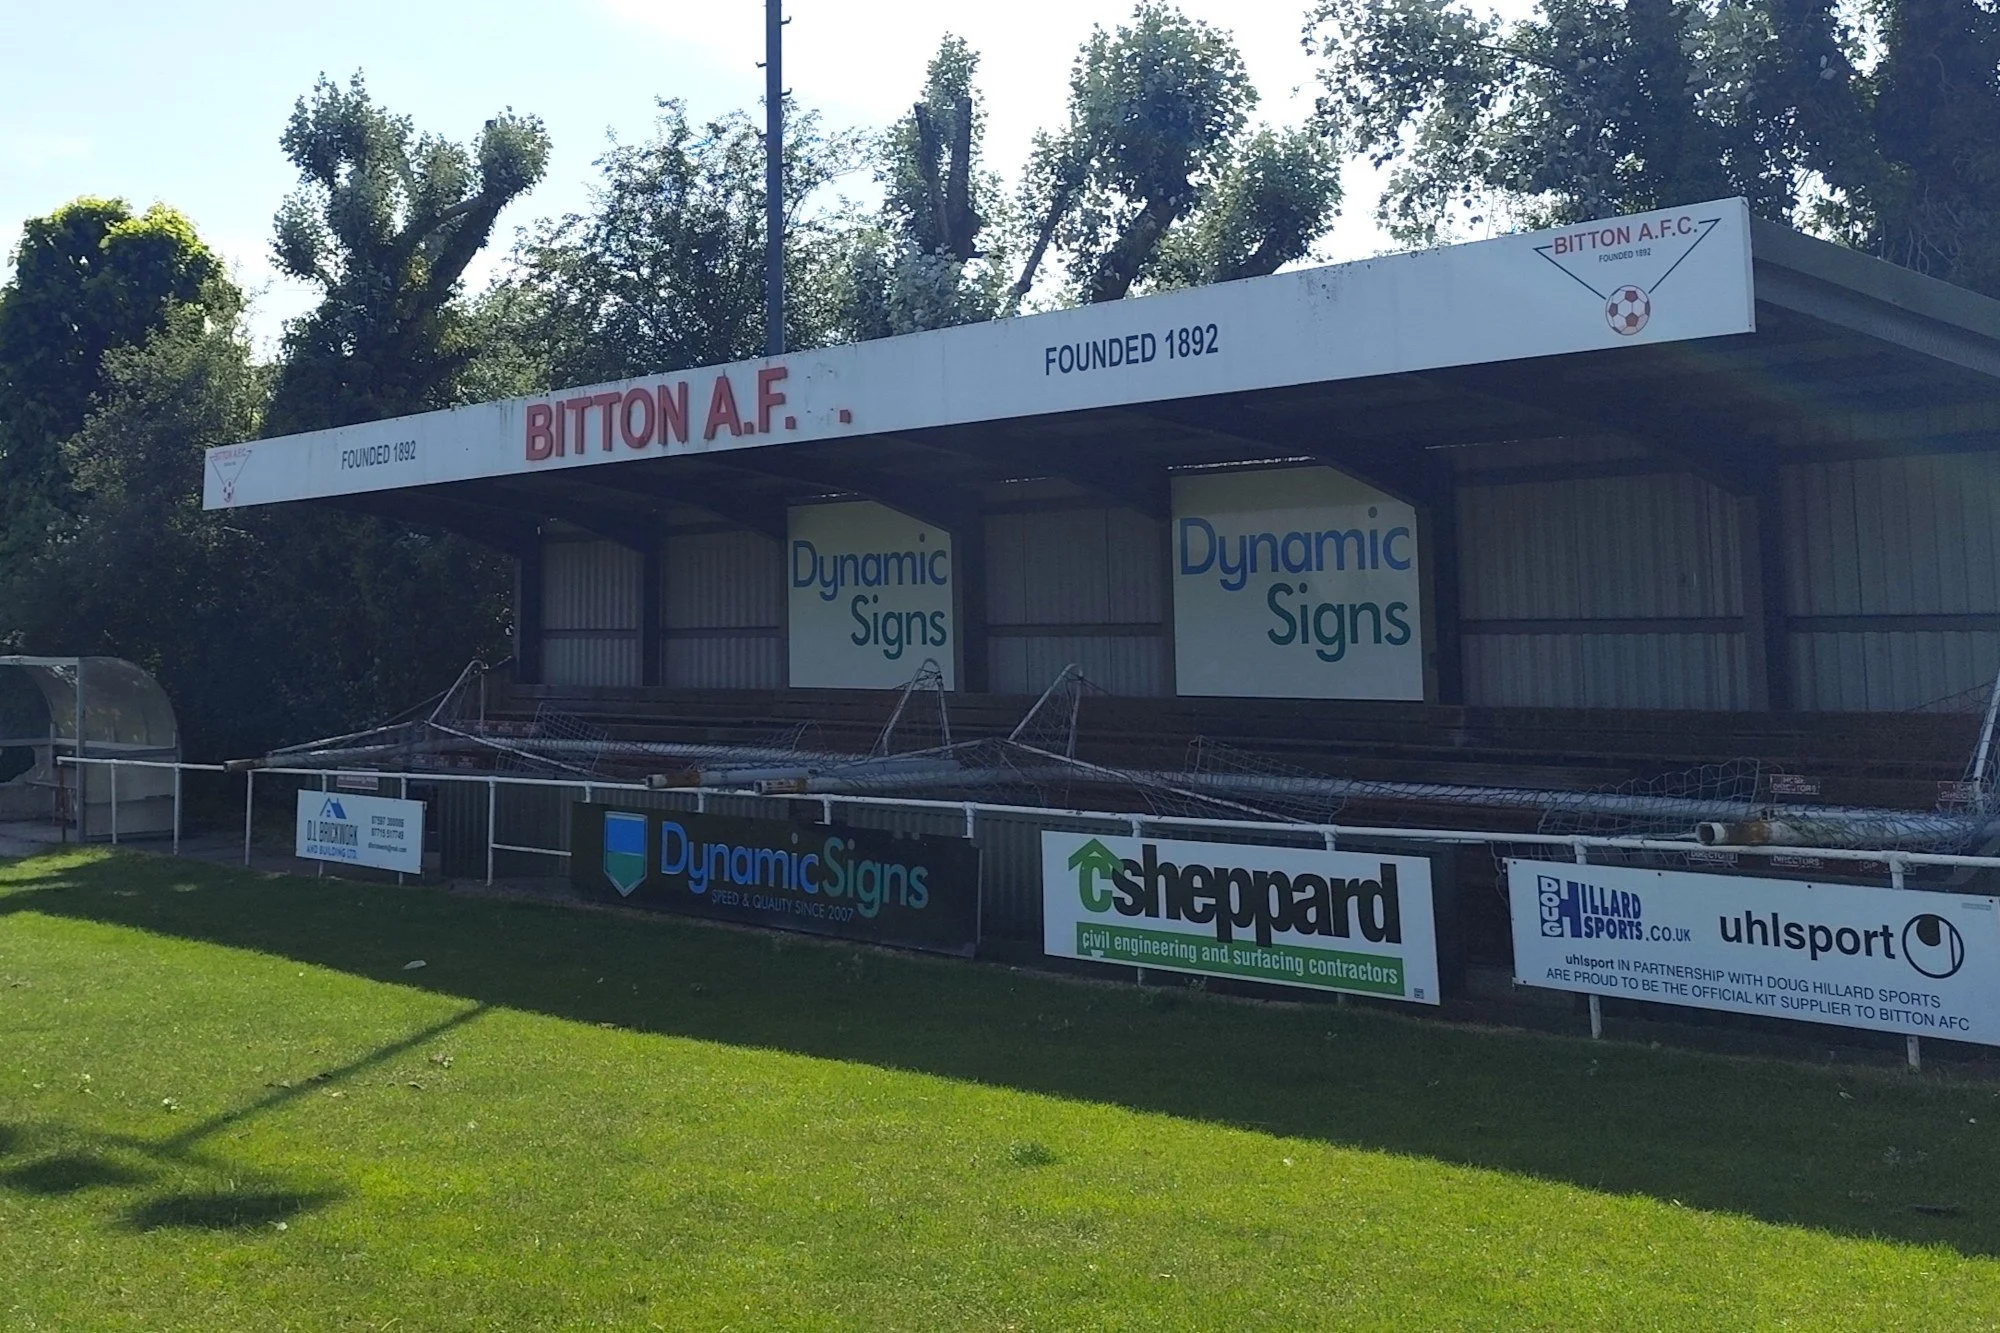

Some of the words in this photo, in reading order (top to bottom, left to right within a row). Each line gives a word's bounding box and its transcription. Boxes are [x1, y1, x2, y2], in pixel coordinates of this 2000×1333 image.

[1554, 226, 1630, 255] BITTON
[1638, 215, 1697, 243] A.F.C.
[1599, 251, 1634, 262] FOUNDED
[1635, 248, 1651, 257] 1892
[1045, 331, 1157, 377] FOUNDED
[1165, 322, 1219, 359] 1892
[525, 381, 688, 462] BITTON
[341, 446, 391, 471] FOUNDED
[393, 440, 417, 464] 1892
[793, 533, 948, 601] Dynamic
[1180, 506, 1412, 591] Dynamic
[850, 594, 947, 660] Signs
[1267, 583, 1411, 662] Signs
[711, 888, 739, 907] SPEED
[742, 892, 750, 907] &
[752, 893, 795, 914] QUALITY
[795, 898, 825, 919] SINCE
[828, 904, 855, 923] 2007
[1539, 876, 1564, 938] DOUG
[1082, 929, 1110, 951] civil
[1114, 935, 1197, 964] engineering
[1201, 943, 1229, 964] and
[1233, 947, 1304, 976] surfacing
[1308, 952, 1398, 985] contractors
[1719, 910, 1896, 961] uhlsport
[1546, 968, 1571, 982] ARE
[1574, 972, 1618, 987] PROUD
[1621, 976, 1639, 990] TO
[1642, 980, 1659, 992] BE
[1662, 981, 1688, 996] THE
[1692, 985, 1752, 1004] OFFICIAL
[1756, 992, 1777, 1006] KIT
[1781, 996, 1851, 1016] SUPPLIER
[1855, 1004, 1875, 1019] TO
[1880, 1008, 1935, 1026] BITTON
[1938, 1016, 1970, 1031] AFC
[1565, 954, 1614, 970] uhlsport
[1617, 959, 1630, 972] IN
[1634, 961, 1725, 982] PARTNERSHIP
[1728, 972, 1763, 988] WITH
[1767, 976, 1809, 992] DOUG
[1813, 981, 1874, 1000] HILLARD
[1879, 989, 1941, 1009] SPORTS
